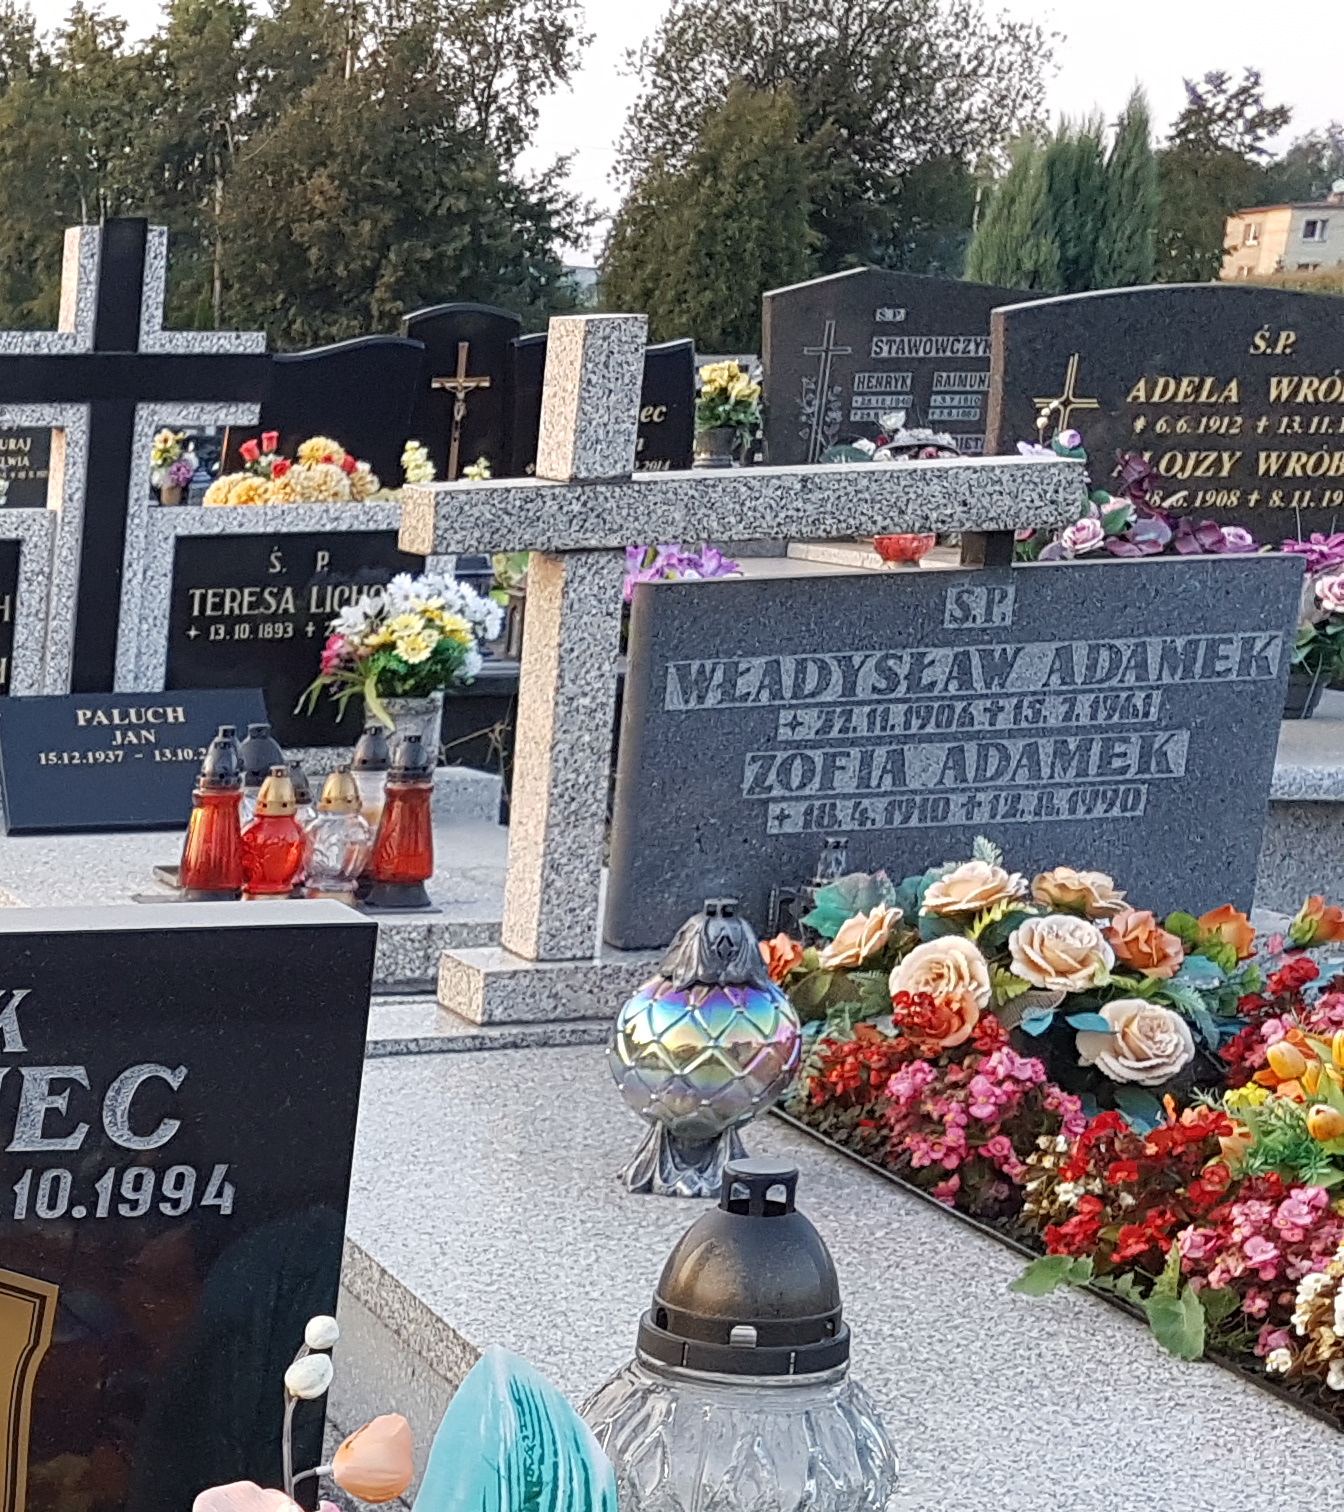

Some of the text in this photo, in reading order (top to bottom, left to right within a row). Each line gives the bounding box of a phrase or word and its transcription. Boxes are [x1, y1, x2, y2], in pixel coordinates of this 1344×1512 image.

[855, 372, 991, 391] HENRYK RAIMUN
[1125, 369, 1344, 403] ADELA WRÓ
[1111, 450, 1243, 479] OJZY
[189, 586, 295, 617] TERESA
[669, 633, 1281, 706] WŁADYSŁAW ADAMEK
[76, 706, 187, 727] PALUCH
[111, 729, 157, 747] JAN
[38, 750, 124, 766] 15.12.1937
[154, 747, 209, 762] 13.10.2
[747, 733, 1182, 798] ZOFIA ADAMEK
